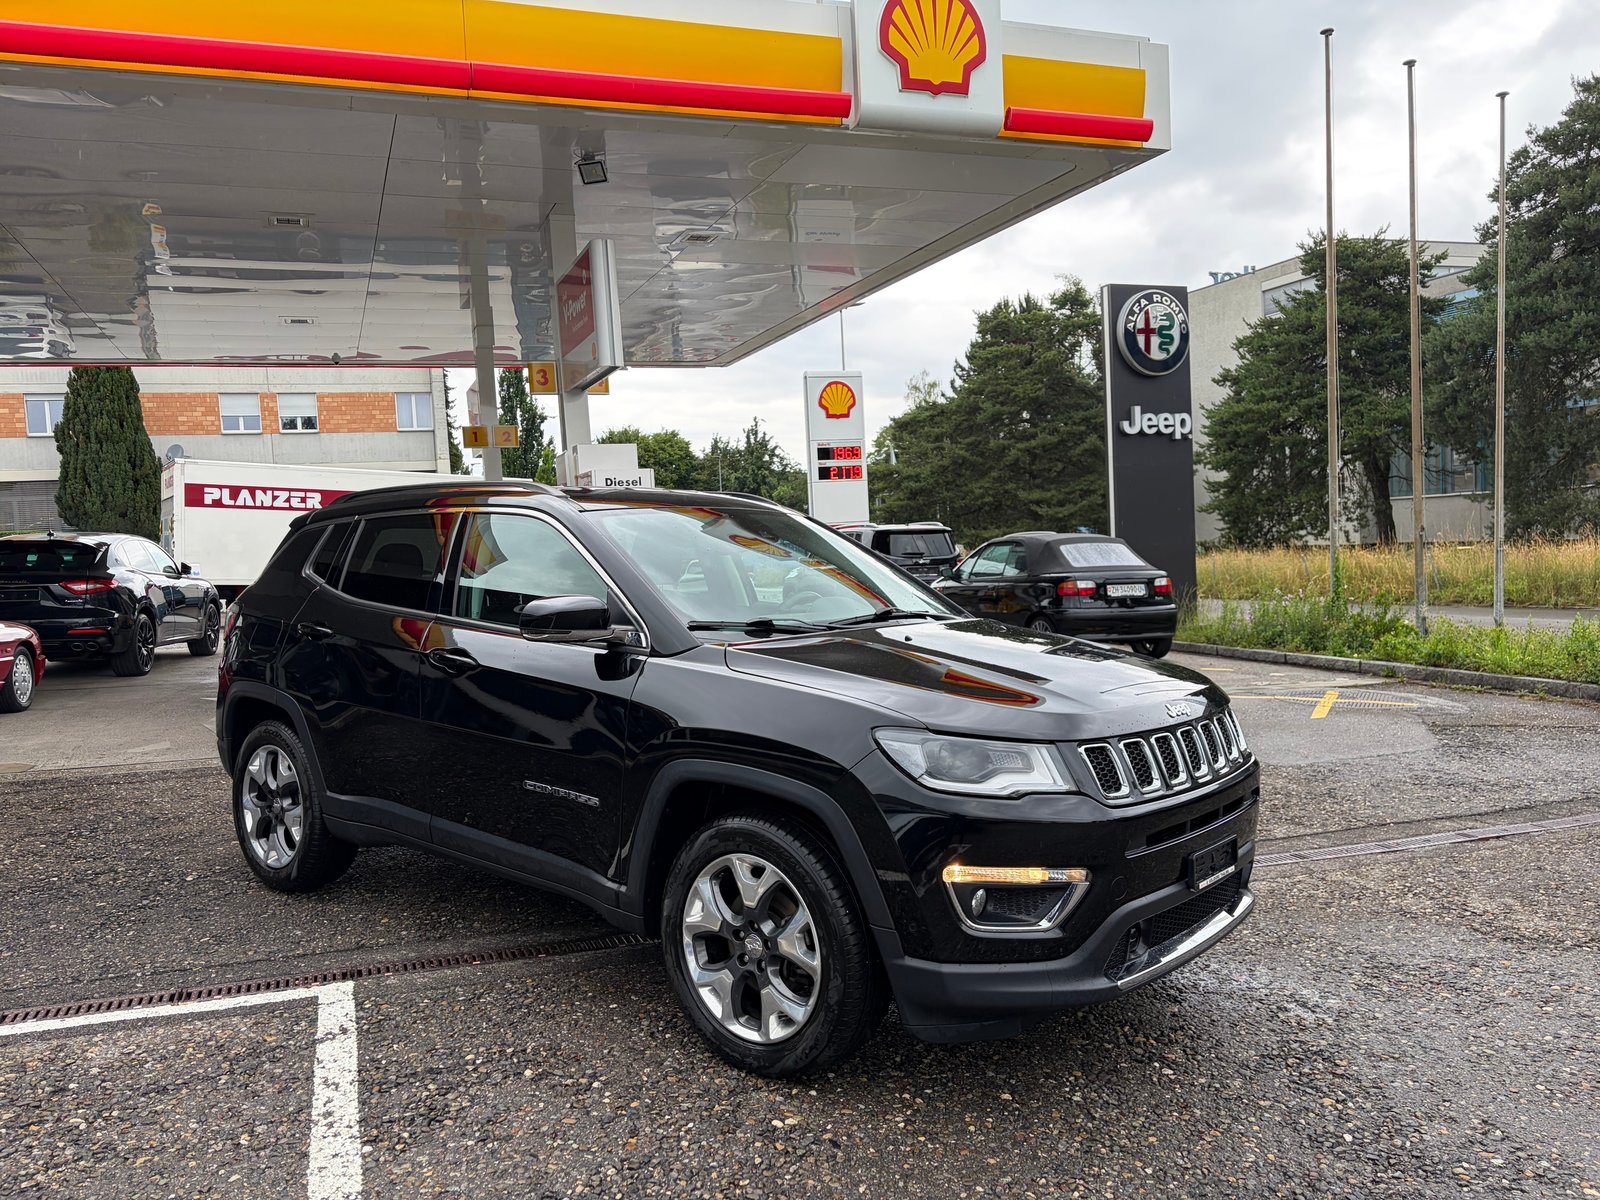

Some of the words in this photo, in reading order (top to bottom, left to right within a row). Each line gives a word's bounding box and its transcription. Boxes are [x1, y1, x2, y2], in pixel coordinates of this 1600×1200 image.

[562, 289, 587, 325] V-Power
[1126, 298, 1149, 333] ALFA
[1153, 294, 1188, 335] ROMEO
[535, 368, 549, 386] 3
[1120, 405, 1191, 440] Jeep
[472, 431, 479, 443] 1
[501, 431, 512, 443] 2
[604, 476, 643, 488] Diesel
[203, 487, 324, 509] PLANZER
[1164, 703, 1191, 718] Jeep
[522, 779, 600, 807] COMPASS
